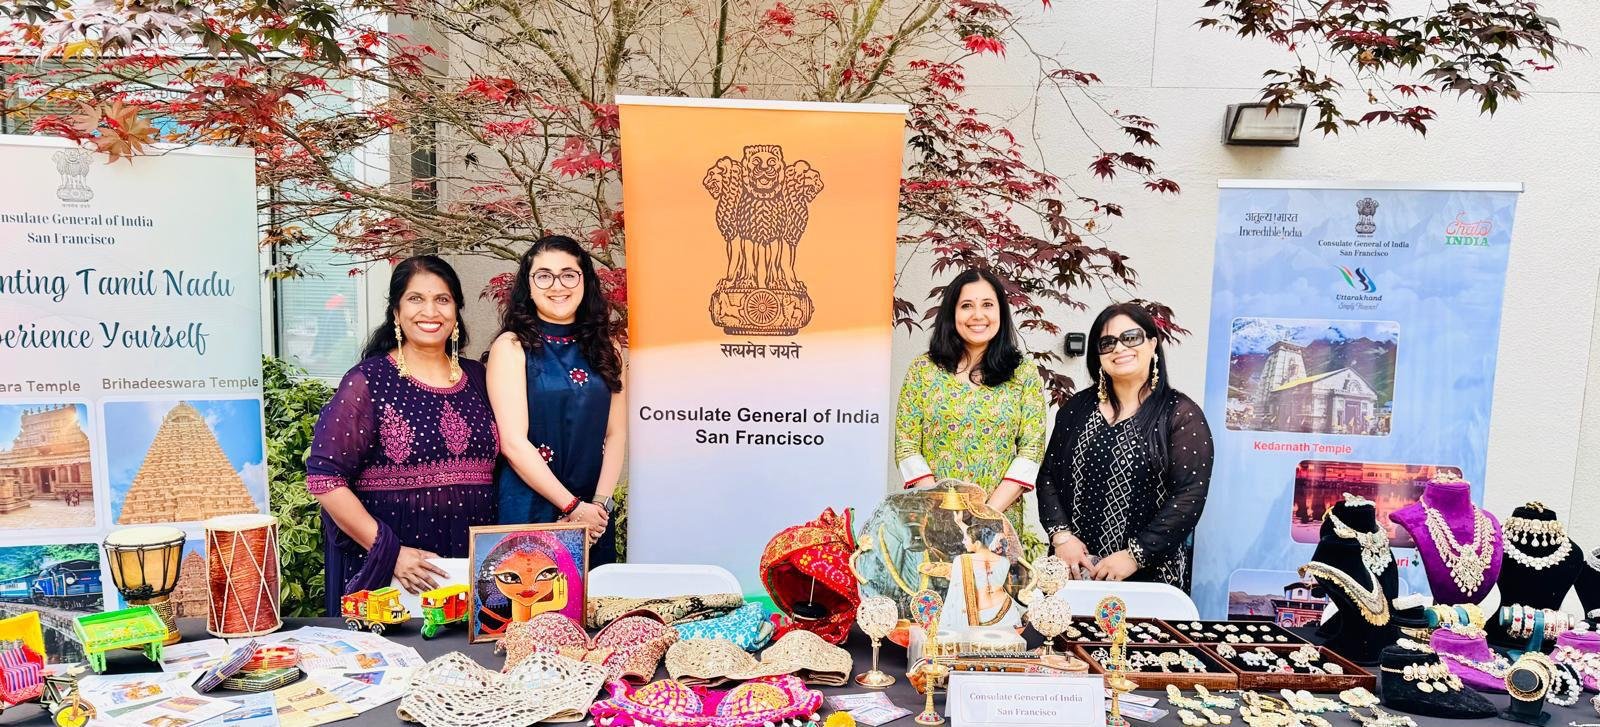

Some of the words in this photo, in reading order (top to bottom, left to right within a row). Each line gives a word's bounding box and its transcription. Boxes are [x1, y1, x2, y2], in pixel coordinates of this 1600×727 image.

[52, 213, 102, 226] General
[105, 214, 119, 226] of
[122, 215, 153, 227] India
[1239, 225, 1281, 237] Incredible
[27, 232, 51, 244] San
[54, 232, 115, 245] Francisco
[1318, 239, 1353, 247] Consulate
[1354, 240, 1382, 248] General
[1383, 240, 1391, 248] of
[1391, 240, 1409, 249] India
[1445, 235, 1489, 247] INDIA
[1339, 249, 1353, 257] San
[1354, 249, 1389, 257] Francisco
[75, 268, 157, 296] Tamil
[163, 269, 235, 296] Nadu
[1336, 294, 1383, 302] Uttarakhand
[99, 322, 209, 356] Yourself
[720, 341, 766, 358] सत्यमेव
[769, 342, 802, 360] जयते
[26, 380, 81, 395] Temple
[102, 377, 206, 390] Brihadeeswara
[209, 377, 259, 390] Temple
[639, 406, 731, 422] Consulate
[737, 407, 807, 424] General
[813, 408, 831, 424] of
[836, 408, 880, 424] India
[695, 429, 729, 445] San
[736, 430, 825, 446] Francisco
[1253, 440, 1310, 452] Kedarnath
[1312, 443, 1352, 455] Temple
[969, 692, 1012, 701] Consulate
[1014, 692, 1048, 702] General
[1049, 693, 1058, 702] of
[1060, 693, 1083, 703] India
[997, 708, 1013, 716] San
[1015, 708, 1057, 717] Francisco
